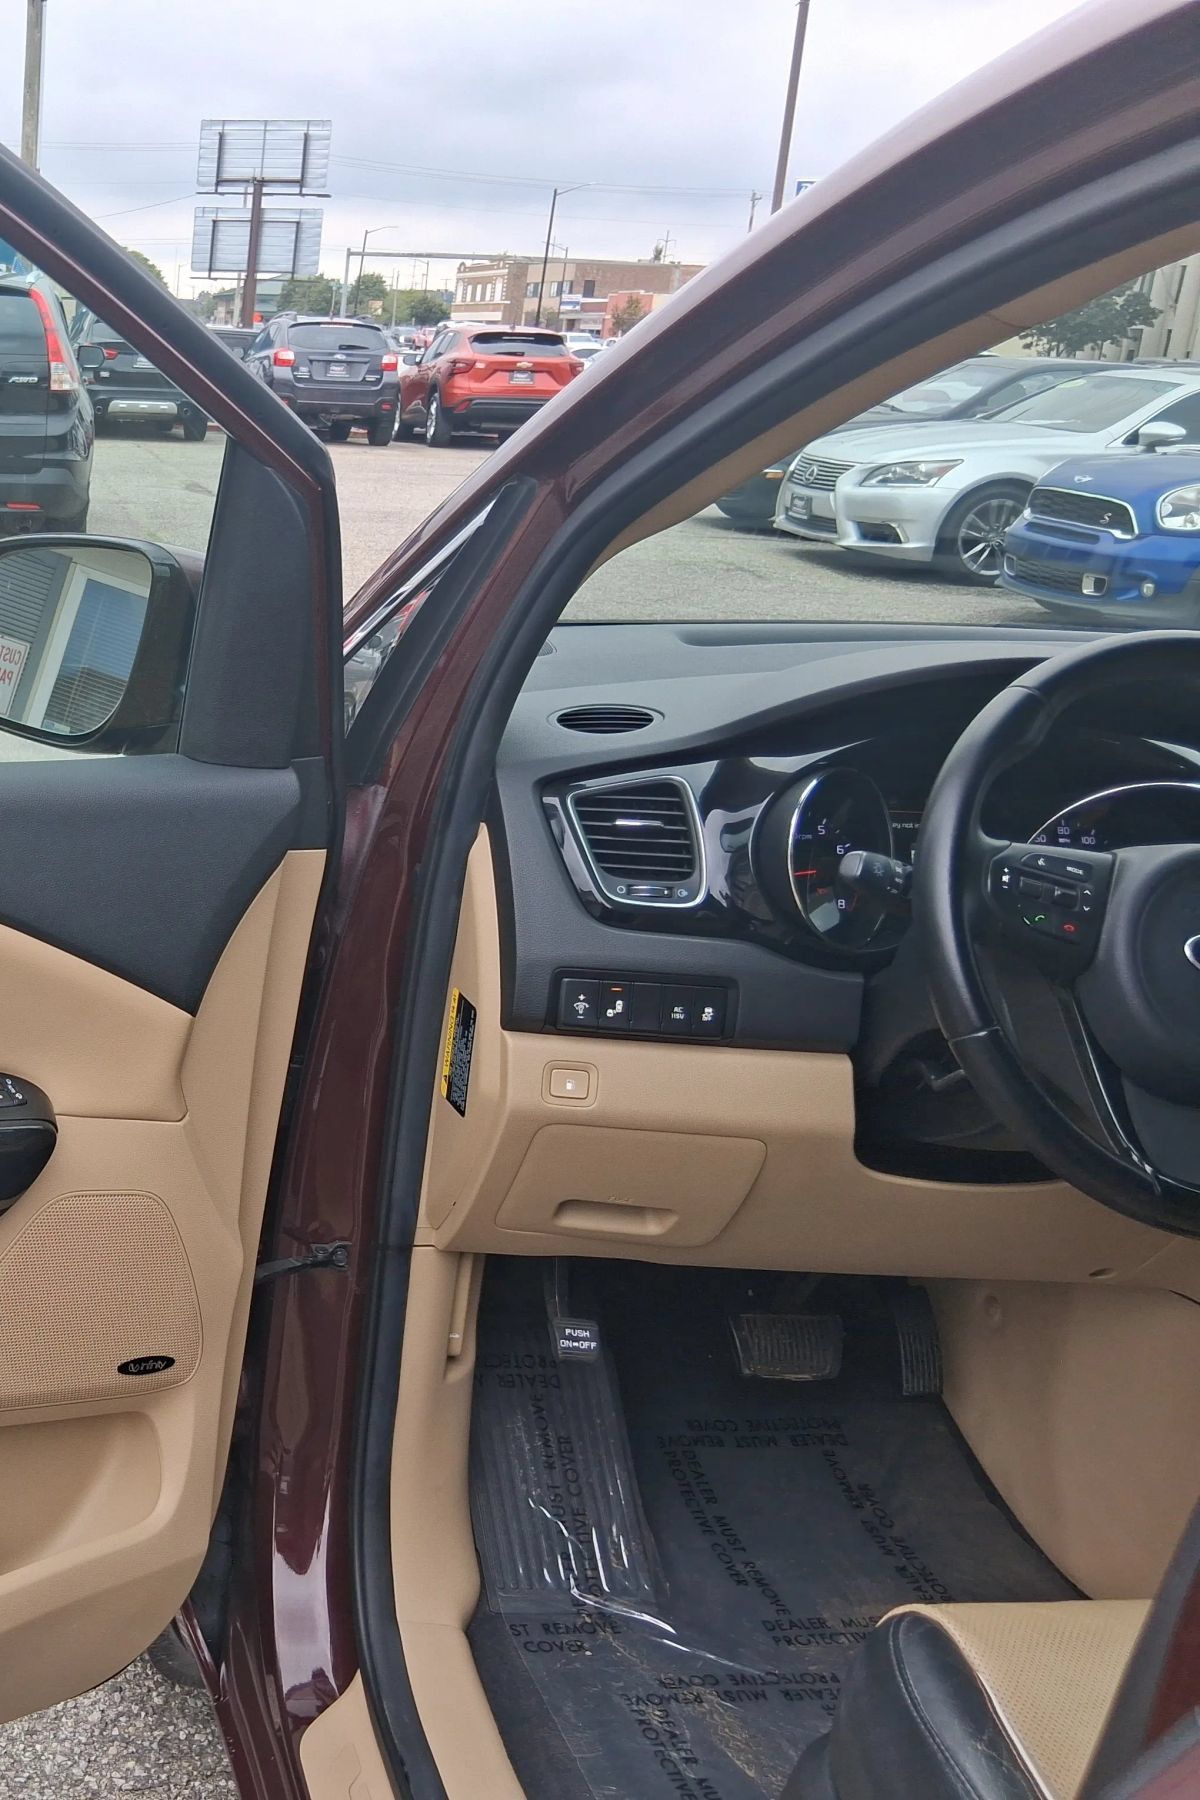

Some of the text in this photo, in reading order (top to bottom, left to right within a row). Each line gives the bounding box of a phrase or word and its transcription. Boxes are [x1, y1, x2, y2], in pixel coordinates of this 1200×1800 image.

[817, 825, 826, 835] 5
[1057, 826, 1070, 835] 80
[1081, 836, 1096, 845] 100
[836, 845, 845, 855] 6
[1066, 865, 1084, 876] MODE
[837, 899, 846, 909] 8
[564, 1328, 590, 1338] PUSH
[484, 1354, 558, 1370] PROTEC
[557, 1436, 583, 1497] COVER
[663, 1450, 750, 1588] PROTECTIVE COVER
[681, 1450, 793, 1617] DEALER MUST REMOVE
[894, 1565, 939, 1604] EALER
[509, 1621, 623, 1637] ST REMOVE
[760, 1615, 881, 1632] DEALER MUS
[523, 1639, 585, 1653] COVER
[771, 1631, 868, 1647] PROTECTIV
[694, 1776, 724, 1800] MU
